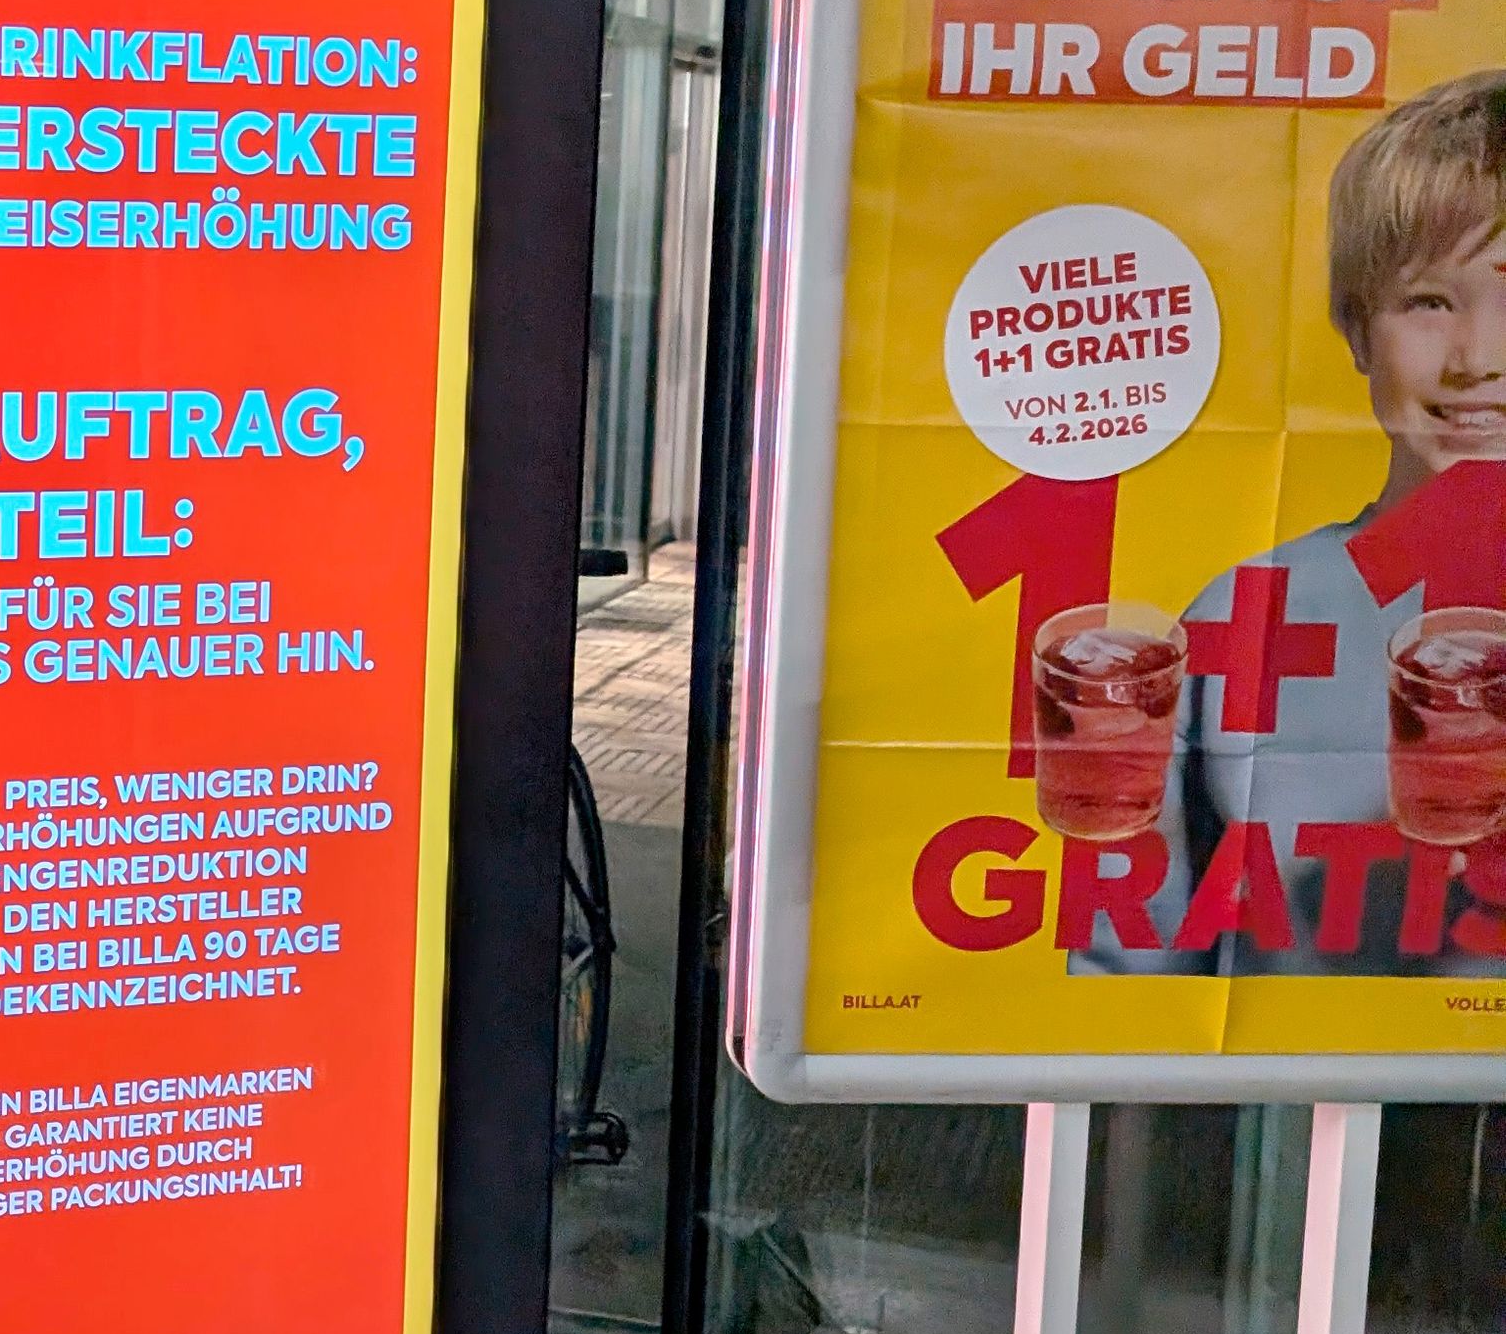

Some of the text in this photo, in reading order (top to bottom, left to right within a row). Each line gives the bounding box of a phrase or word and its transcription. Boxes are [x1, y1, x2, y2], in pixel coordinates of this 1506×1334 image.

[940, 22, 1376, 99] IHR GELD
[1019, 251, 1137, 294] VIELE
[969, 284, 1191, 340] PRODUKTE
[974, 324, 1190, 378] 1+1 GRATIS
[1005, 382, 1167, 420] VON 2.1. BIS
[1028, 414, 1148, 446] 4.2.2026
[106, 584, 181, 627] SIE
[196, 581, 270, 624] BEI
[24, 634, 264, 683] GENAUER
[278, 630, 374, 673] HIN.
[6, 777, 107, 809] PREIS,
[114, 768, 273, 803] WENIGER
[282, 762, 378, 795] DRIN?
[211, 802, 392, 839] AUFGRUND
[4, 901, 77, 933] DEN
[88, 887, 302, 927] HERSTELLER
[34, 941, 87, 972] BEI
[99, 934, 196, 967] BILLA
[204, 930, 246, 960] 90
[254, 924, 340, 956] TAGE
[842, 994, 922, 1009] BILLA.AT
[30, 1084, 108, 1113] BILLA
[115, 1067, 312, 1106] EIGENMARKEN
[5, 1111, 178, 1148] GARANTIERT
[184, 1103, 262, 1132] KEINE
[157, 1137, 252, 1167] DURCH
[51, 1164, 302, 1210] PACKUNGSINHALT!
